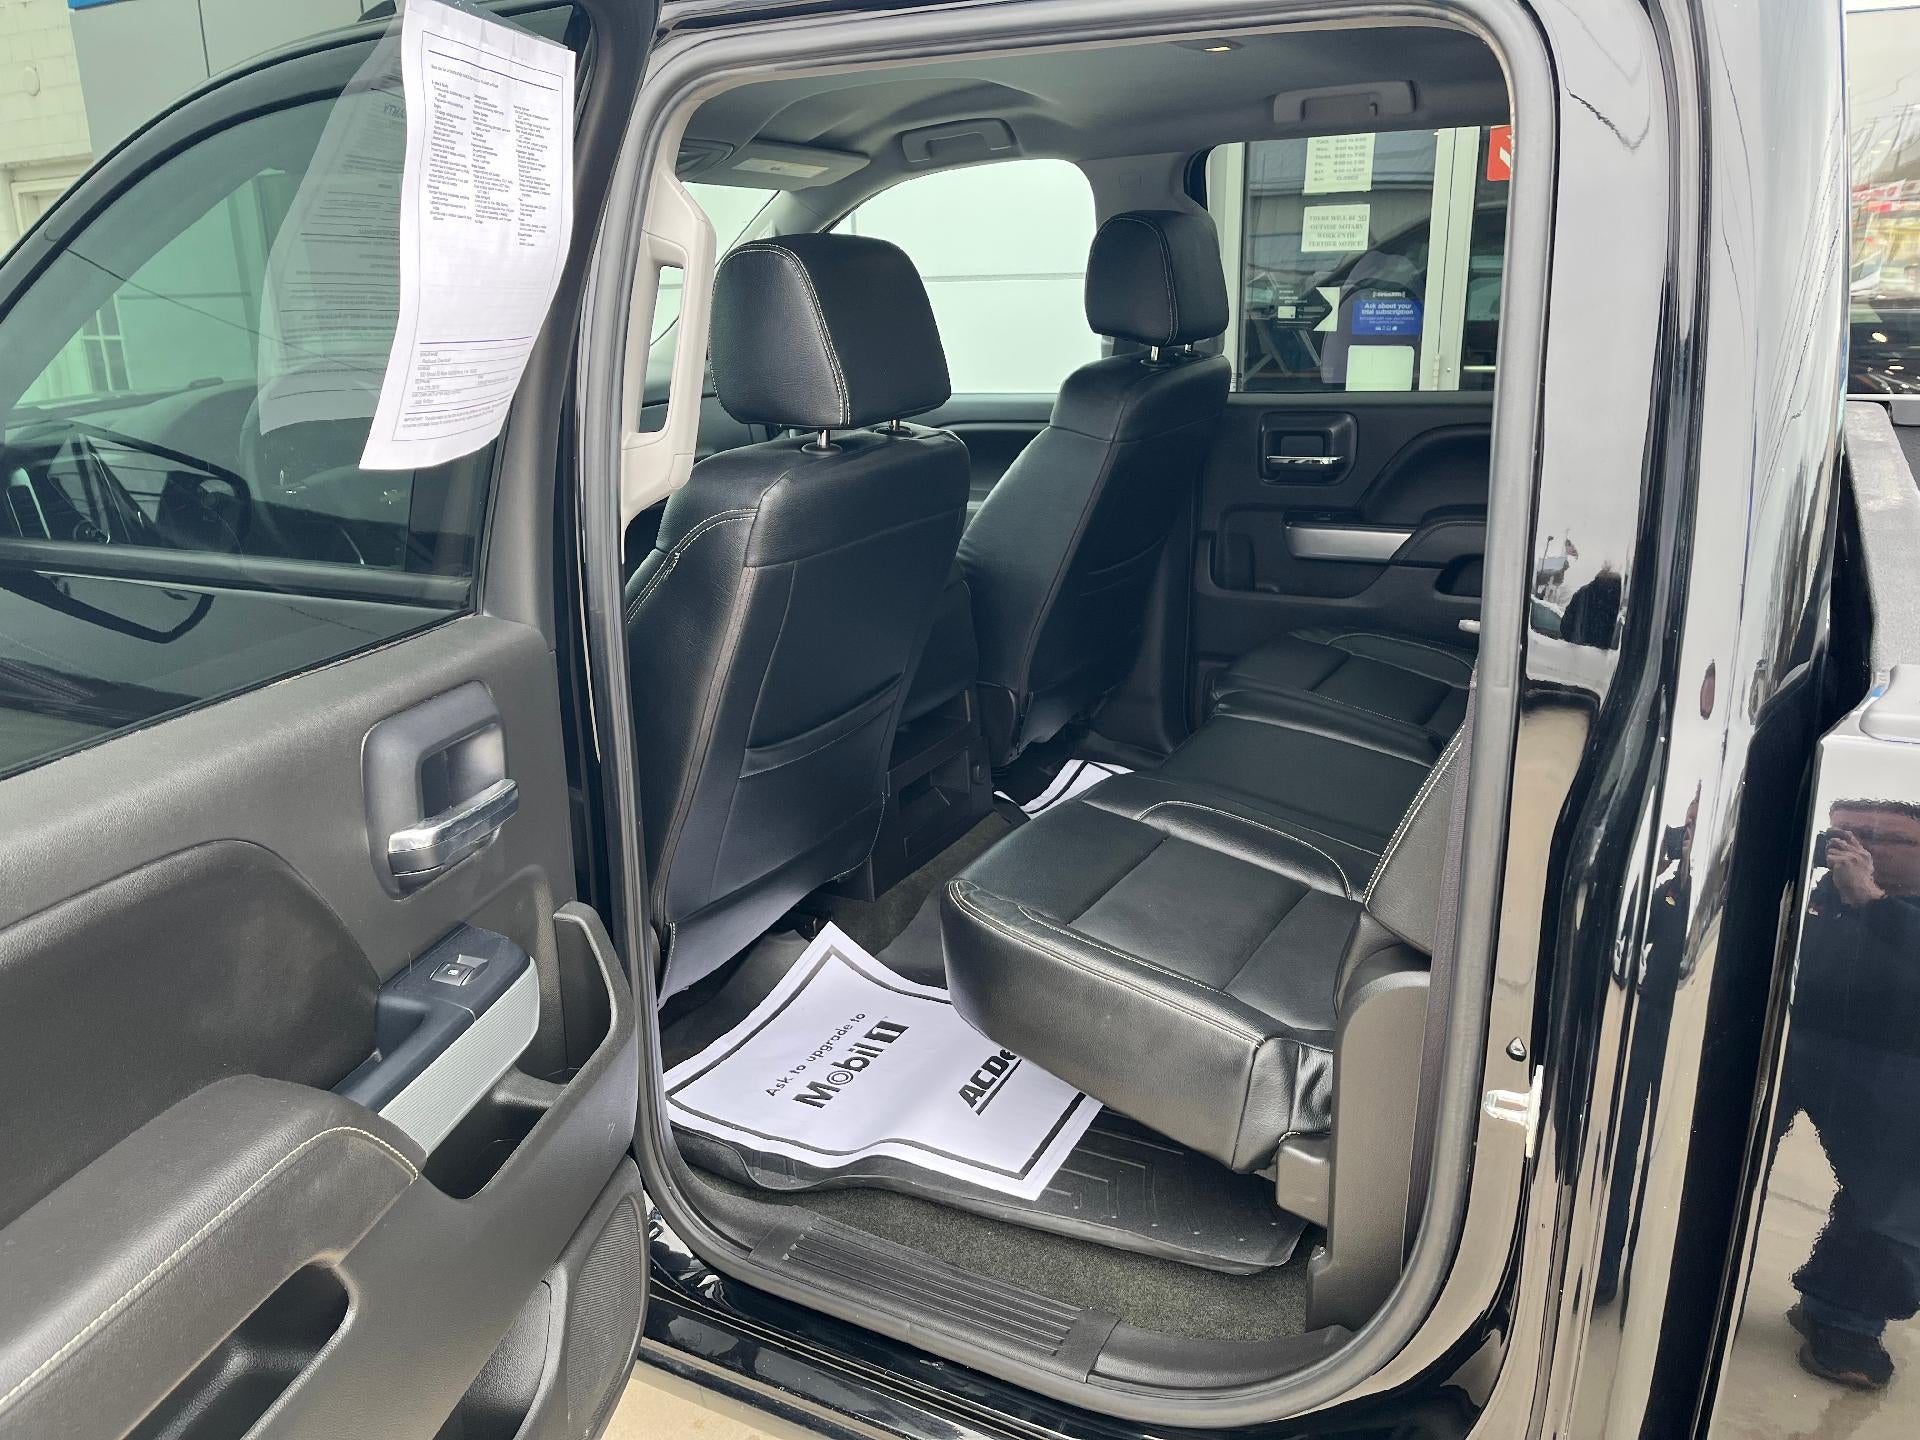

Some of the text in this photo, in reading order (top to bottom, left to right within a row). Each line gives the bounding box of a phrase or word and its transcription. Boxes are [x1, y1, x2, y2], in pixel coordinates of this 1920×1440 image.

[765, 1013, 866, 1097] Ask to upgrade to
[792, 1042, 885, 1109] Mobil
